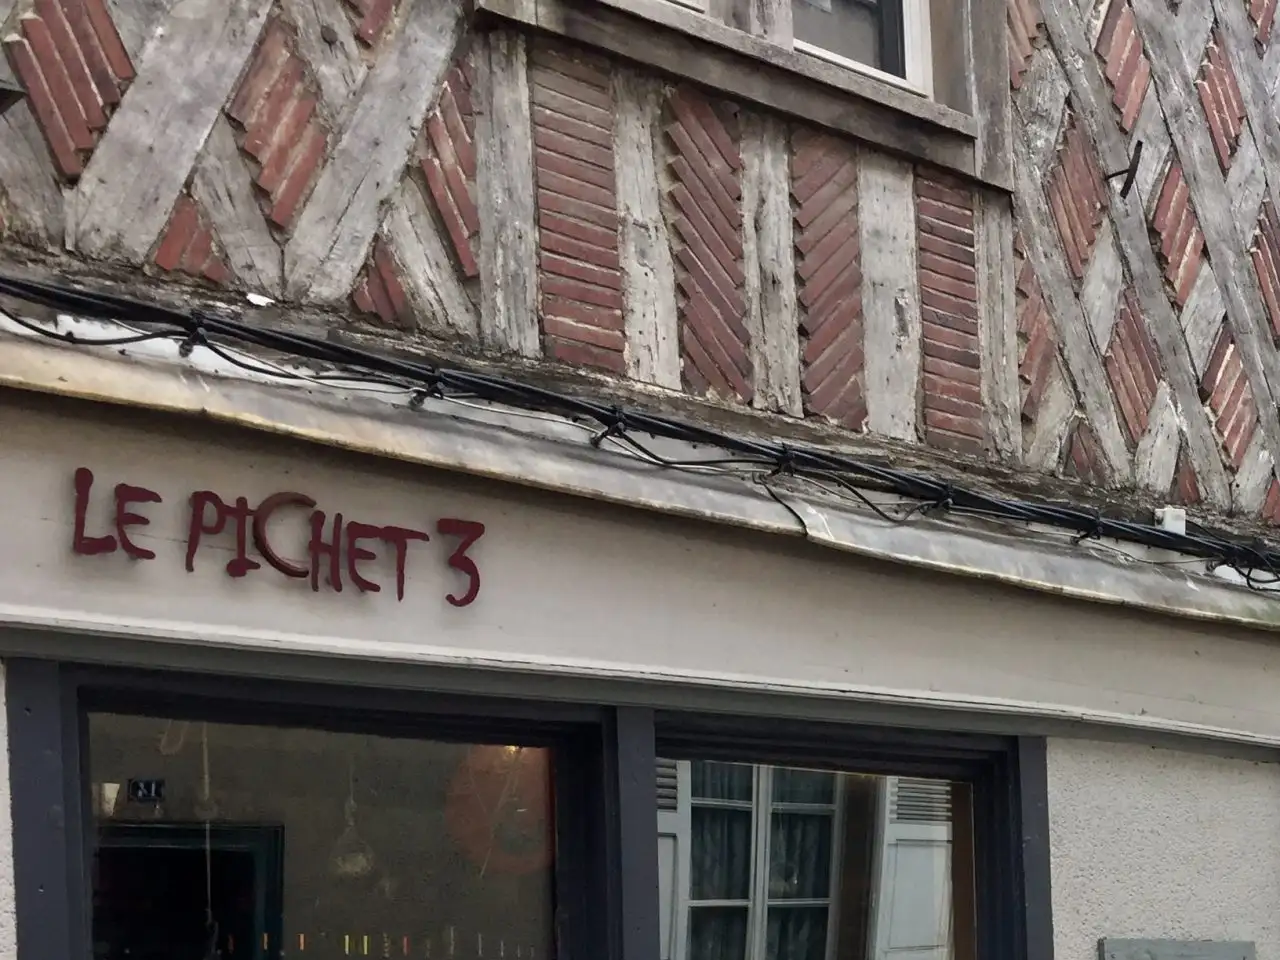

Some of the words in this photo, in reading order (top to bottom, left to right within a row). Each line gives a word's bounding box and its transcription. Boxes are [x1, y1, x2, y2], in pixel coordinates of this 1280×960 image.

[73, 467, 164, 560] LE
[185, 491, 430, 602] PICHET
[436, 518, 486, 608] 3
